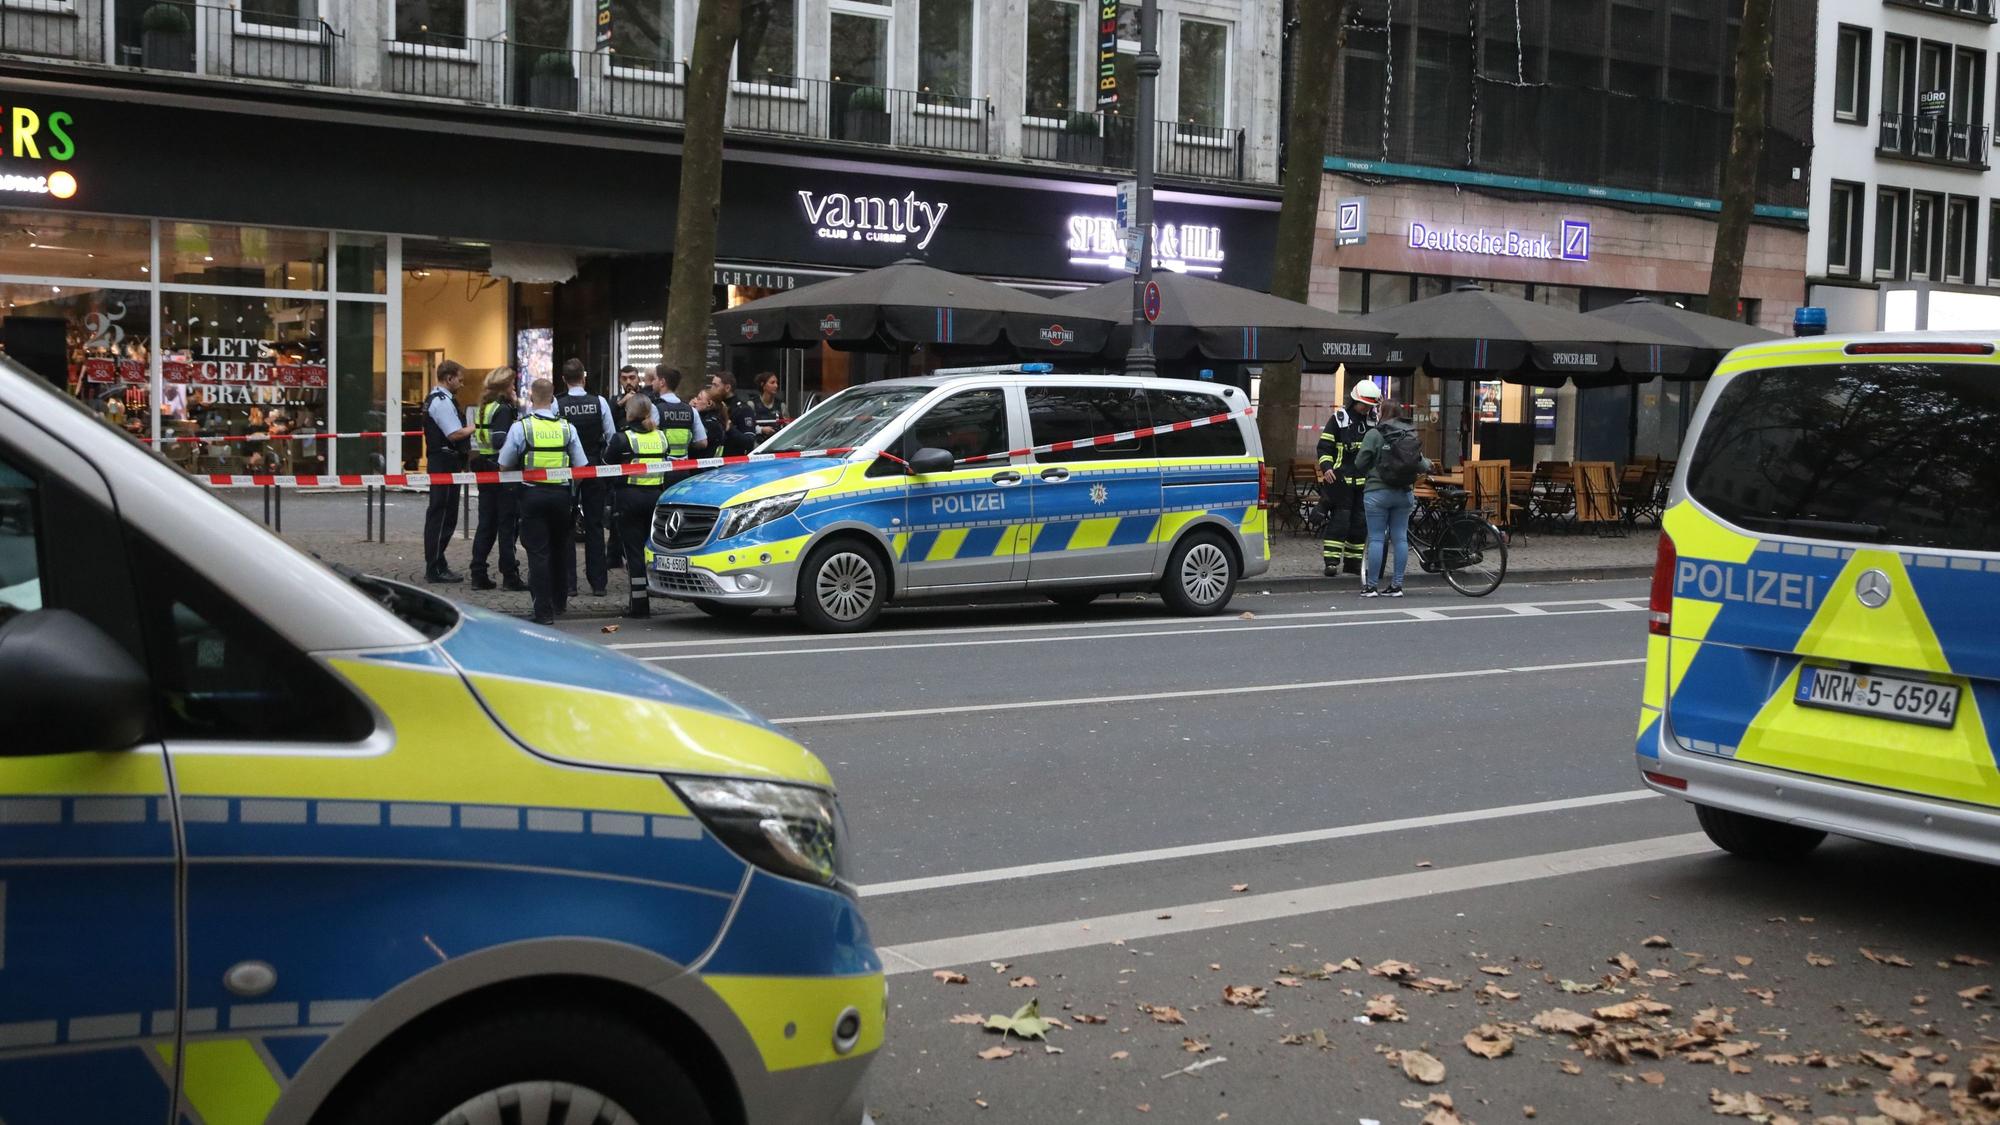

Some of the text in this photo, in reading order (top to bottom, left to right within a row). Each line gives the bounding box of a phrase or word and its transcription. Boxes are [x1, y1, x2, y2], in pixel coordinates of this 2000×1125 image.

[1921, 92, 1946, 102] BÜRO
[0, 106, 75, 160] RS
[798, 190, 949, 250] vanity
[817, 227, 848, 239] CLUB
[852, 230, 862, 241] &
[1068, 216, 1158, 257] SPENR
[1161, 224, 1178, 258] &
[1181, 225, 1224, 261] HILL
[1409, 222, 1553, 259] Deutsche Bank
[714, 270, 795, 290] IGHTCLUB
[1041, 329, 1073, 341] MARTINI
[201, 336, 273, 358] LET'S
[1322, 342, 1372, 356] SPENCER & HILL
[1553, 352, 1579, 365] SPENCER
[1585, 353, 1598, 366] HILL
[202, 361, 270, 382] CELE
[564, 404, 598, 416] POLIZEI
[664, 411, 692, 421] POLIZEI
[535, 430, 562, 440] POLIZEI
[639, 440, 662, 450] POLIZEI
[931, 492, 1005, 515] POLIZEI
[1677, 560, 1814, 610] POLIZEI
[1812, 672, 1951, 718] NRW 5-6594
